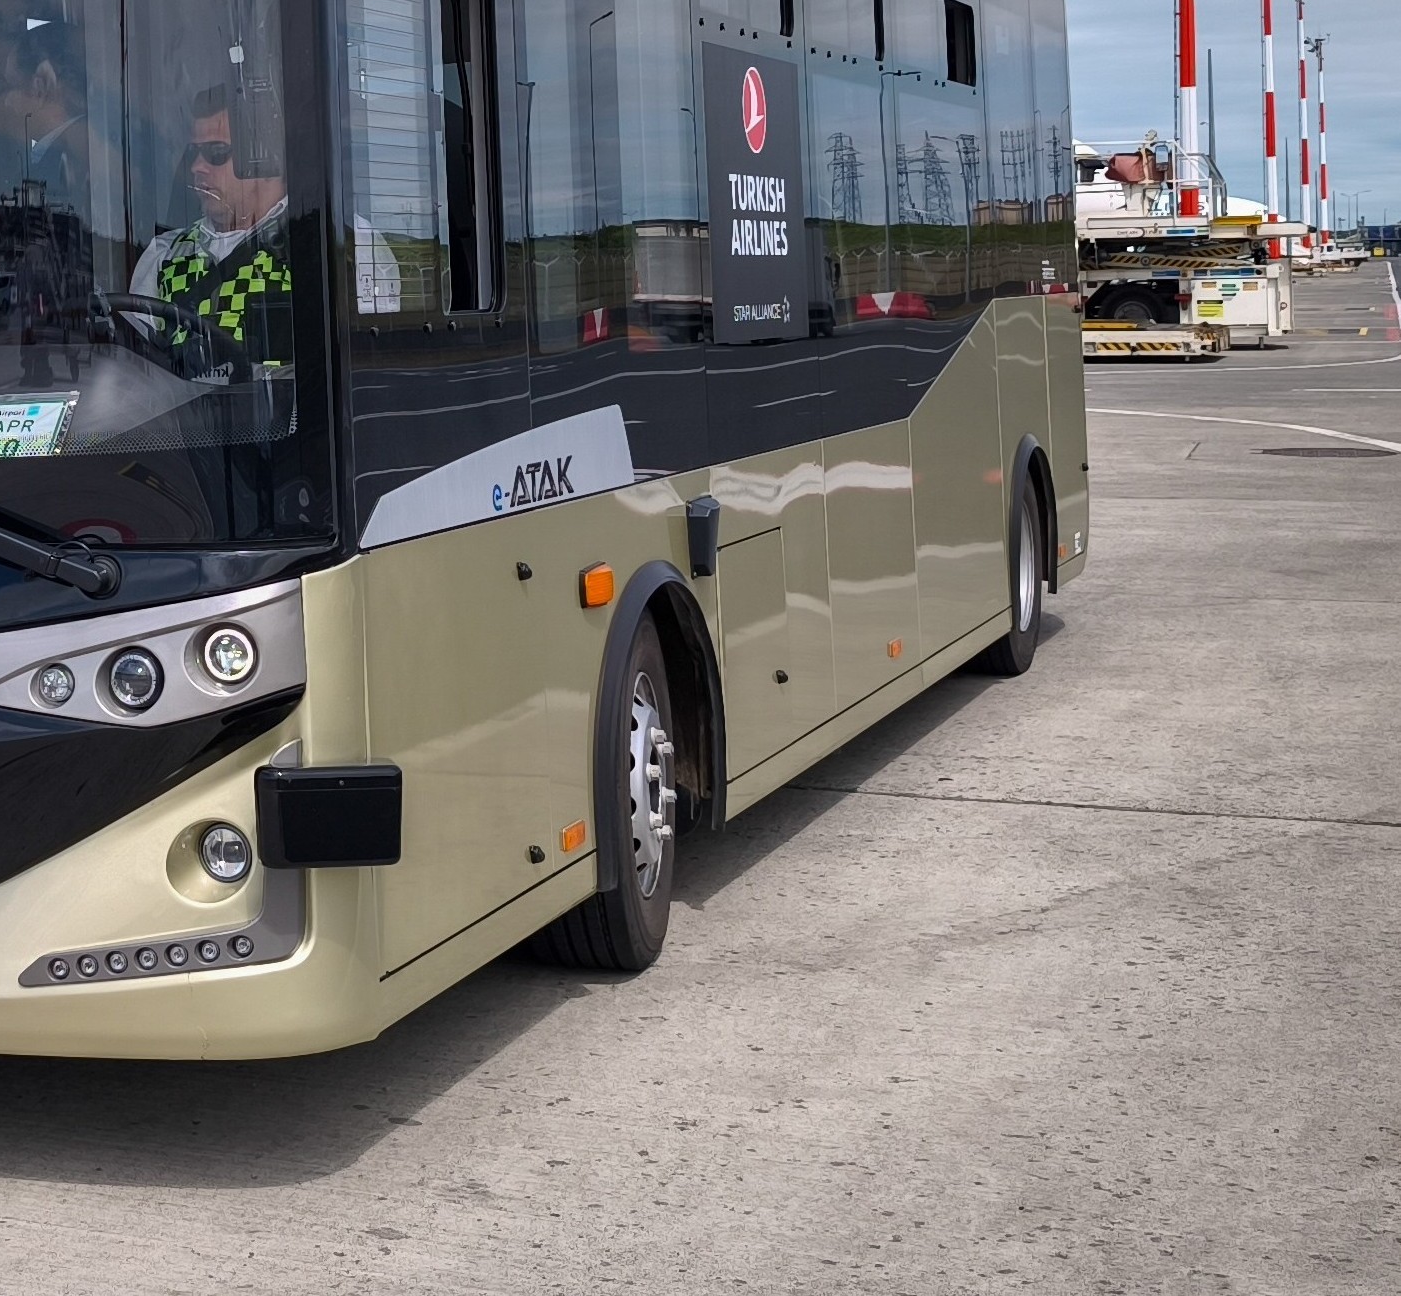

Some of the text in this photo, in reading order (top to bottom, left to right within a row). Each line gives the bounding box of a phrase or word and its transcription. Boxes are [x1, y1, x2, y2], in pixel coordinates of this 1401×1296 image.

[728, 173, 786, 213] TURKISH
[731, 219, 789, 256] AIRLINES
[733, 303, 782, 322] STAR ALLIANCE
[492, 454, 574, 512] e-ATAK
